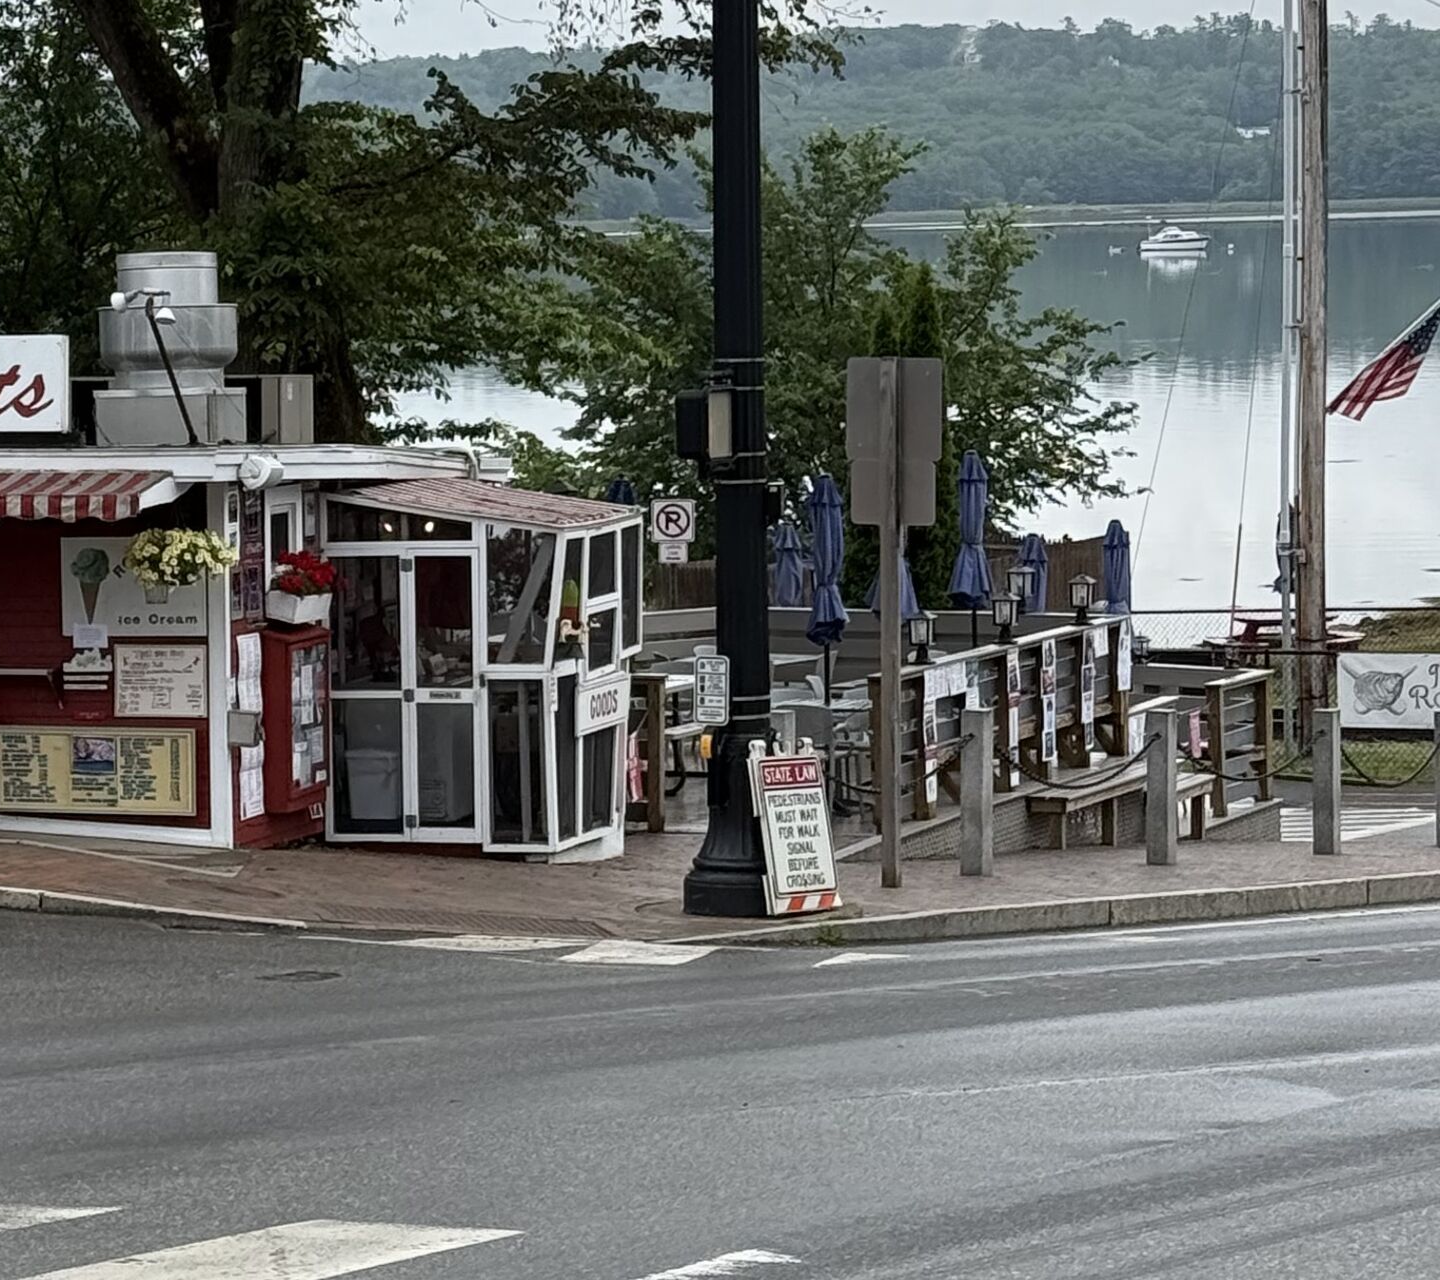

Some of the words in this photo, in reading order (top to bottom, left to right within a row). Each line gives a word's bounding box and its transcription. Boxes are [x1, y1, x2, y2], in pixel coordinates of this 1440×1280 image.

[118, 615, 141, 625] Ice
[148, 613, 198, 625] Cream
[590, 688, 619, 720] GOODS
[763, 766, 793, 784] STATE
[794, 764, 818, 782] LAW
[767, 791, 822, 809] PEDESTRIANS
[774, 809, 797, 823] MUST
[799, 807, 818, 822] WAIT
[778, 825, 794, 839] FOR
[796, 823, 821, 838] WALK
[786, 841, 816, 855] SIGNAL
[787, 856, 820, 871] BEFORE
[786, 872, 826, 888] CROSSING
